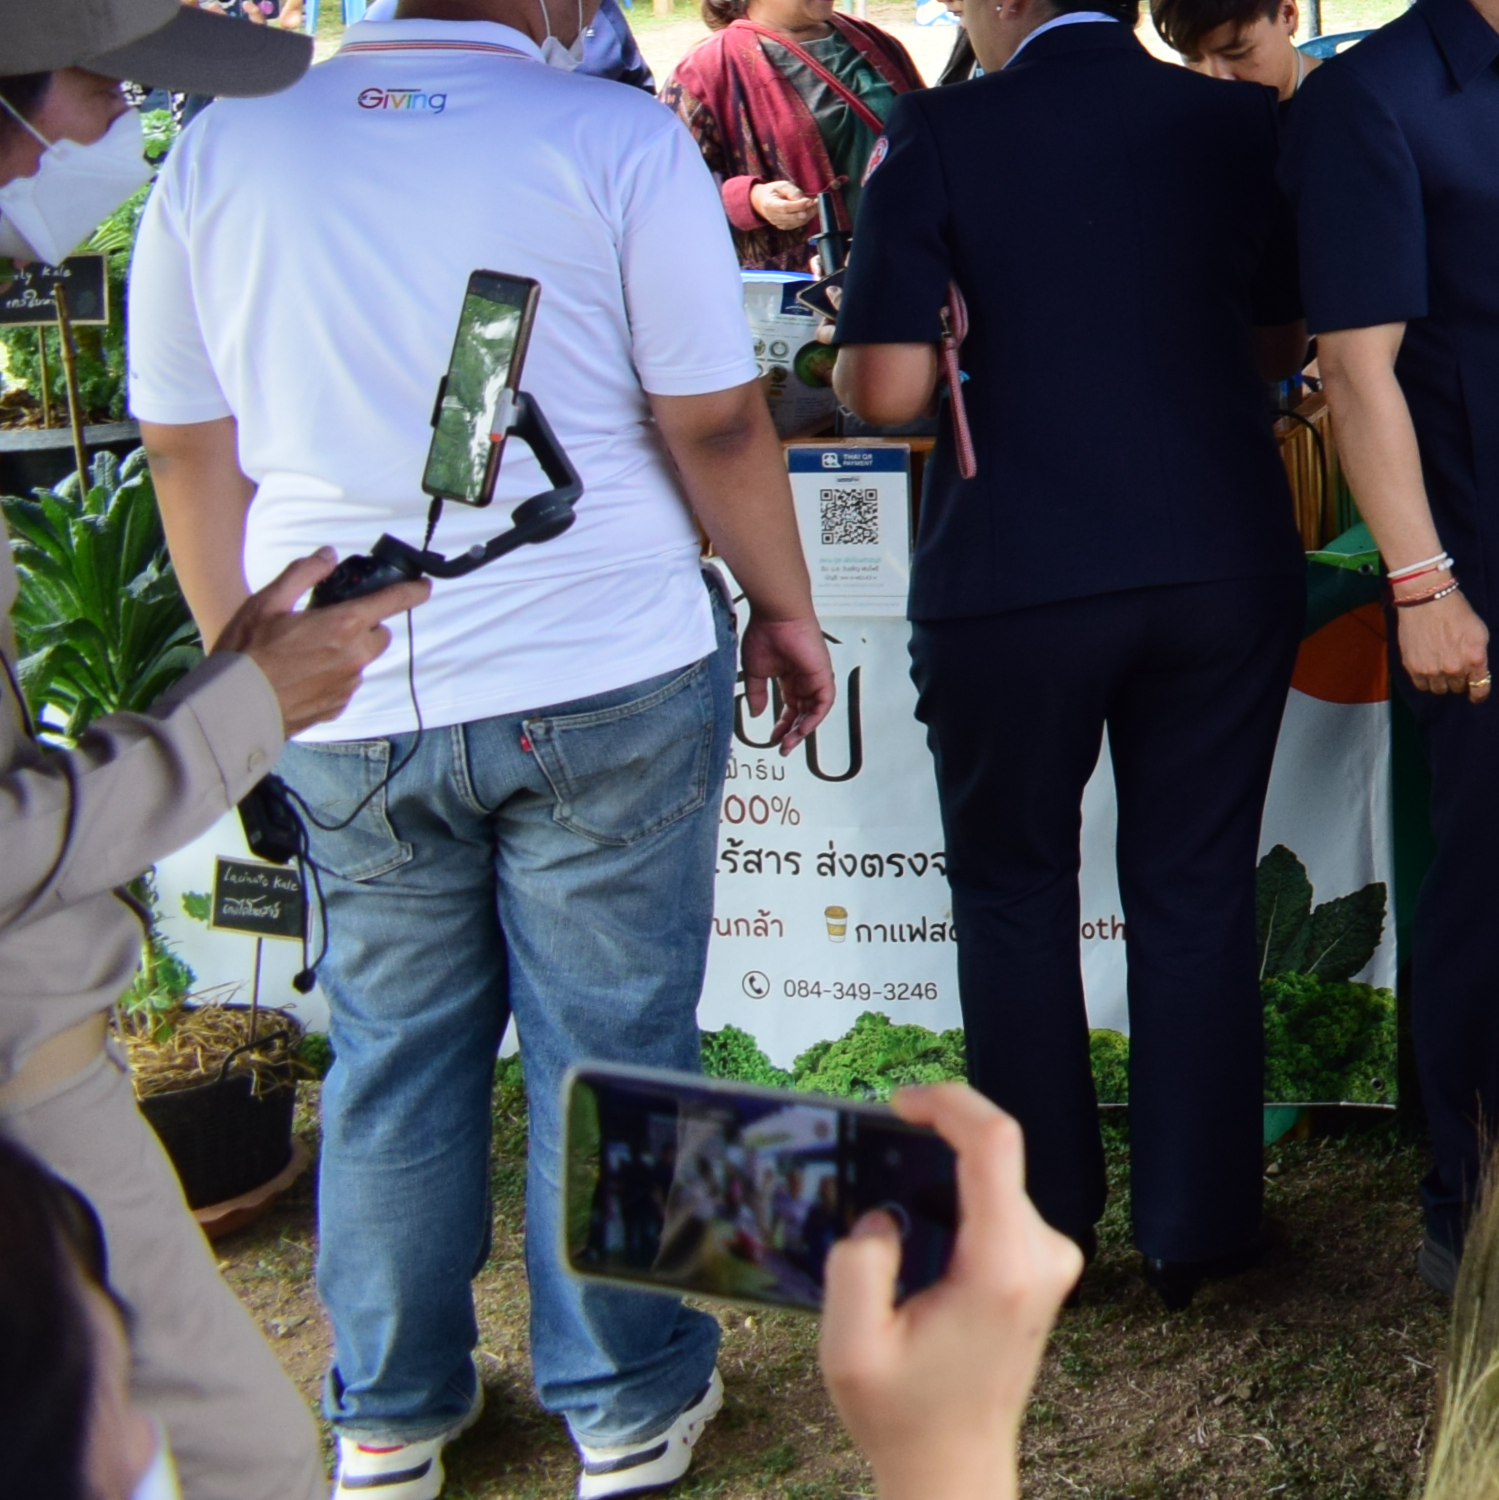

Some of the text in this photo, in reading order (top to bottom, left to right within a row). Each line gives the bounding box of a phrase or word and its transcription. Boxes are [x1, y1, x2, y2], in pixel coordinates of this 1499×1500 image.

[357, 86, 449, 115] Giving
[718, 793, 802, 828] 00%
[715, 837, 948, 880] ร้สาร ส่งตรงจ
[712, 908, 785, 939] นกล้า
[1081, 914, 1126, 941] oth
[783, 978, 940, 1002] 084-349-3246
